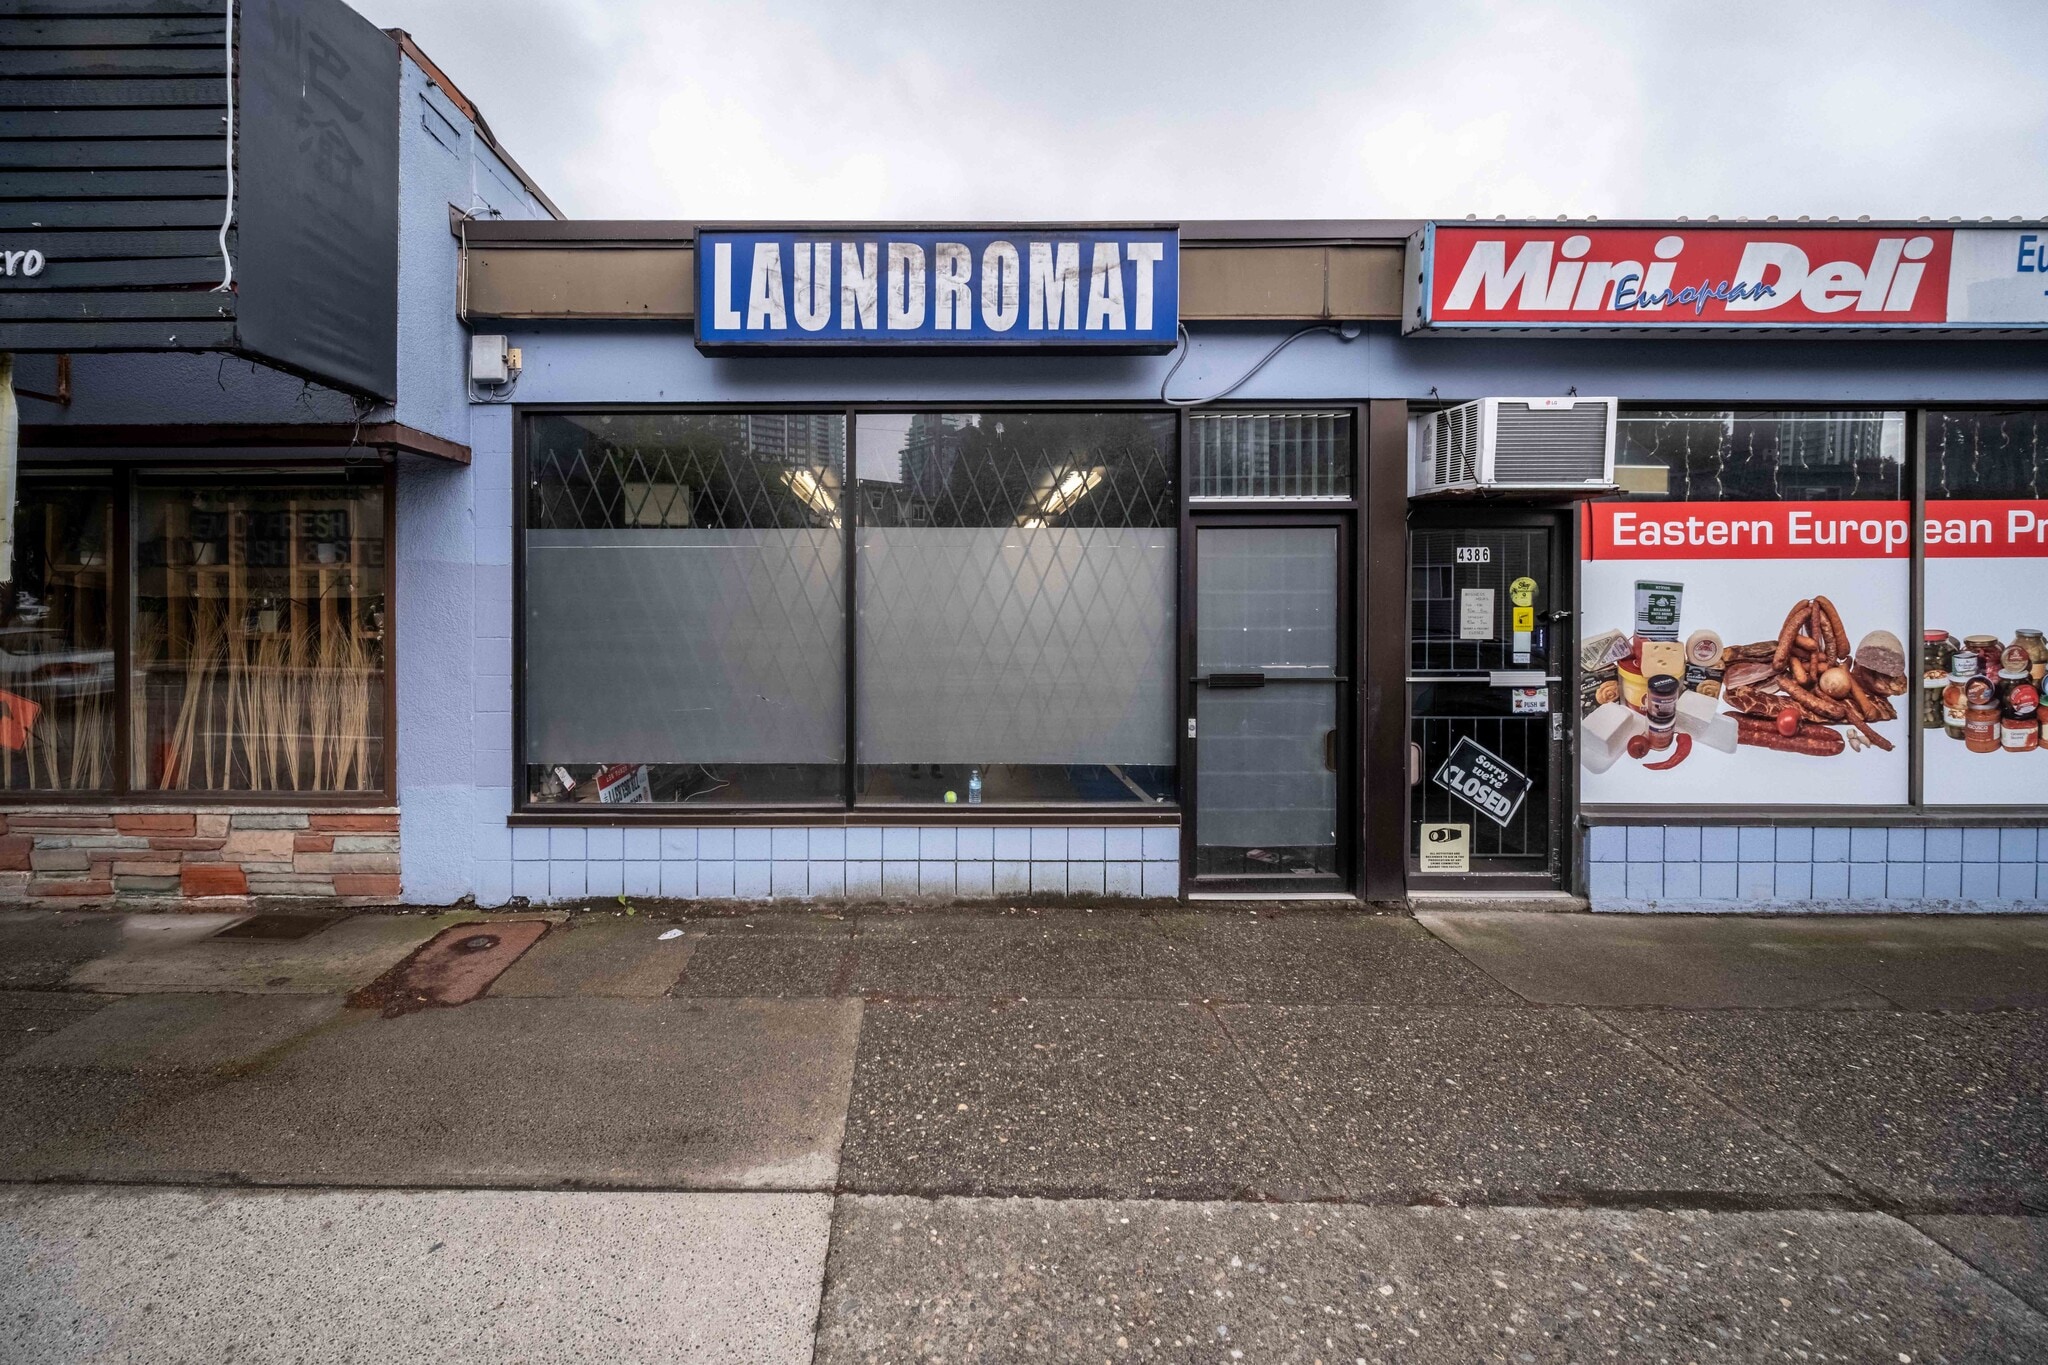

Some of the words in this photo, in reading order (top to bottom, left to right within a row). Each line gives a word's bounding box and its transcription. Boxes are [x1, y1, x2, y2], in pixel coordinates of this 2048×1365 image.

[713, 240, 1163, 332] LAUNDROMAT
[1442, 235, 1685, 312] Mini
[1724, 236, 1934, 313] Deli
[1614, 273, 1777, 317] European
[1612, 512, 1773, 546] Eastern
[1458, 548, 1489, 562] 4386
[1523, 700, 1538, 708] PUSH
[1471, 766, 1504, 789] we're
[1475, 754, 1509, 783] Sorry,
[1443, 765, 1511, 817] CLOSED
